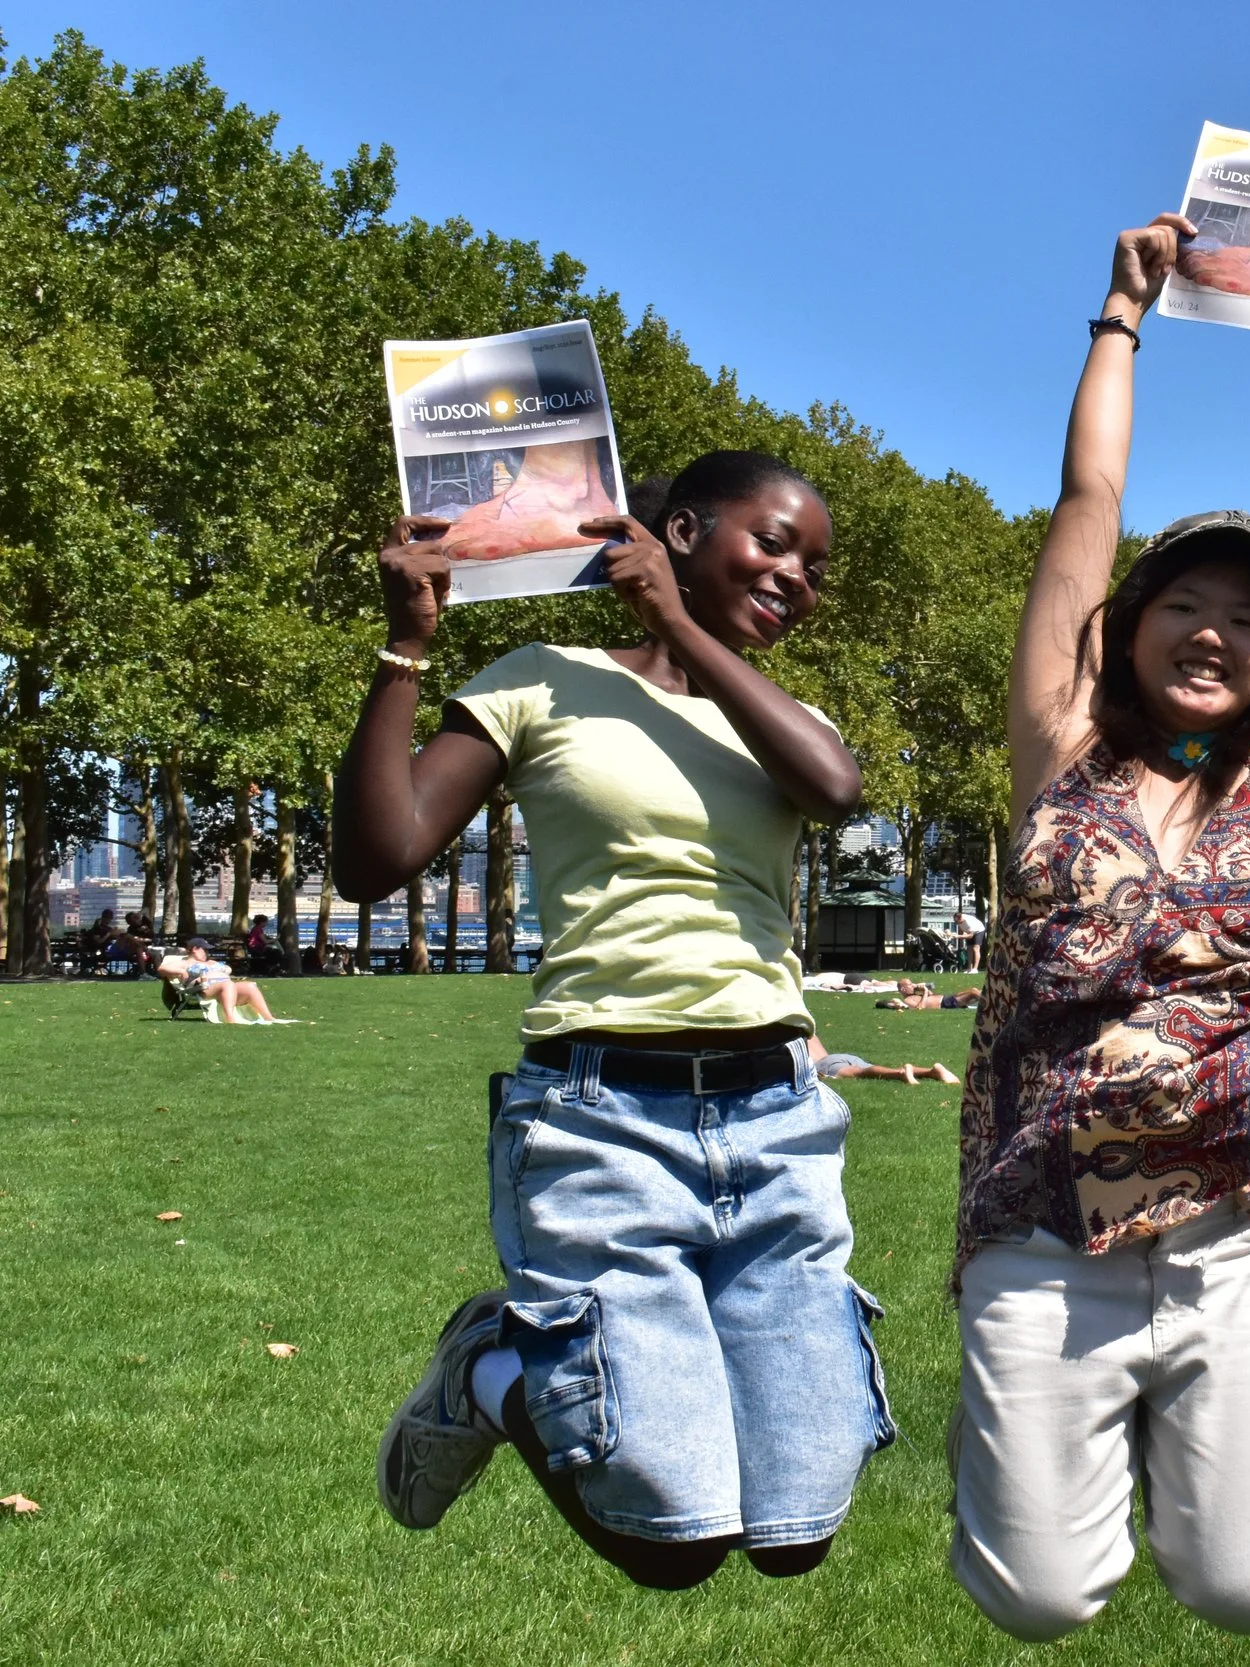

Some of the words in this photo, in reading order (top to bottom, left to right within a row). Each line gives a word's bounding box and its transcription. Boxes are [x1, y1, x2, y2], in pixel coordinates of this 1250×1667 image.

[1188, 302, 1199, 311] 24
[409, 401, 491, 422] HUDSON
[514, 388, 597, 414] SCHOLAR
[410, 397, 427, 406] THE
[431, 430, 471, 438] student-run
[471, 426, 503, 436] magazine
[503, 423, 522, 432] based
[531, 421, 557, 430] Hudson
[556, 417, 580, 426] County
